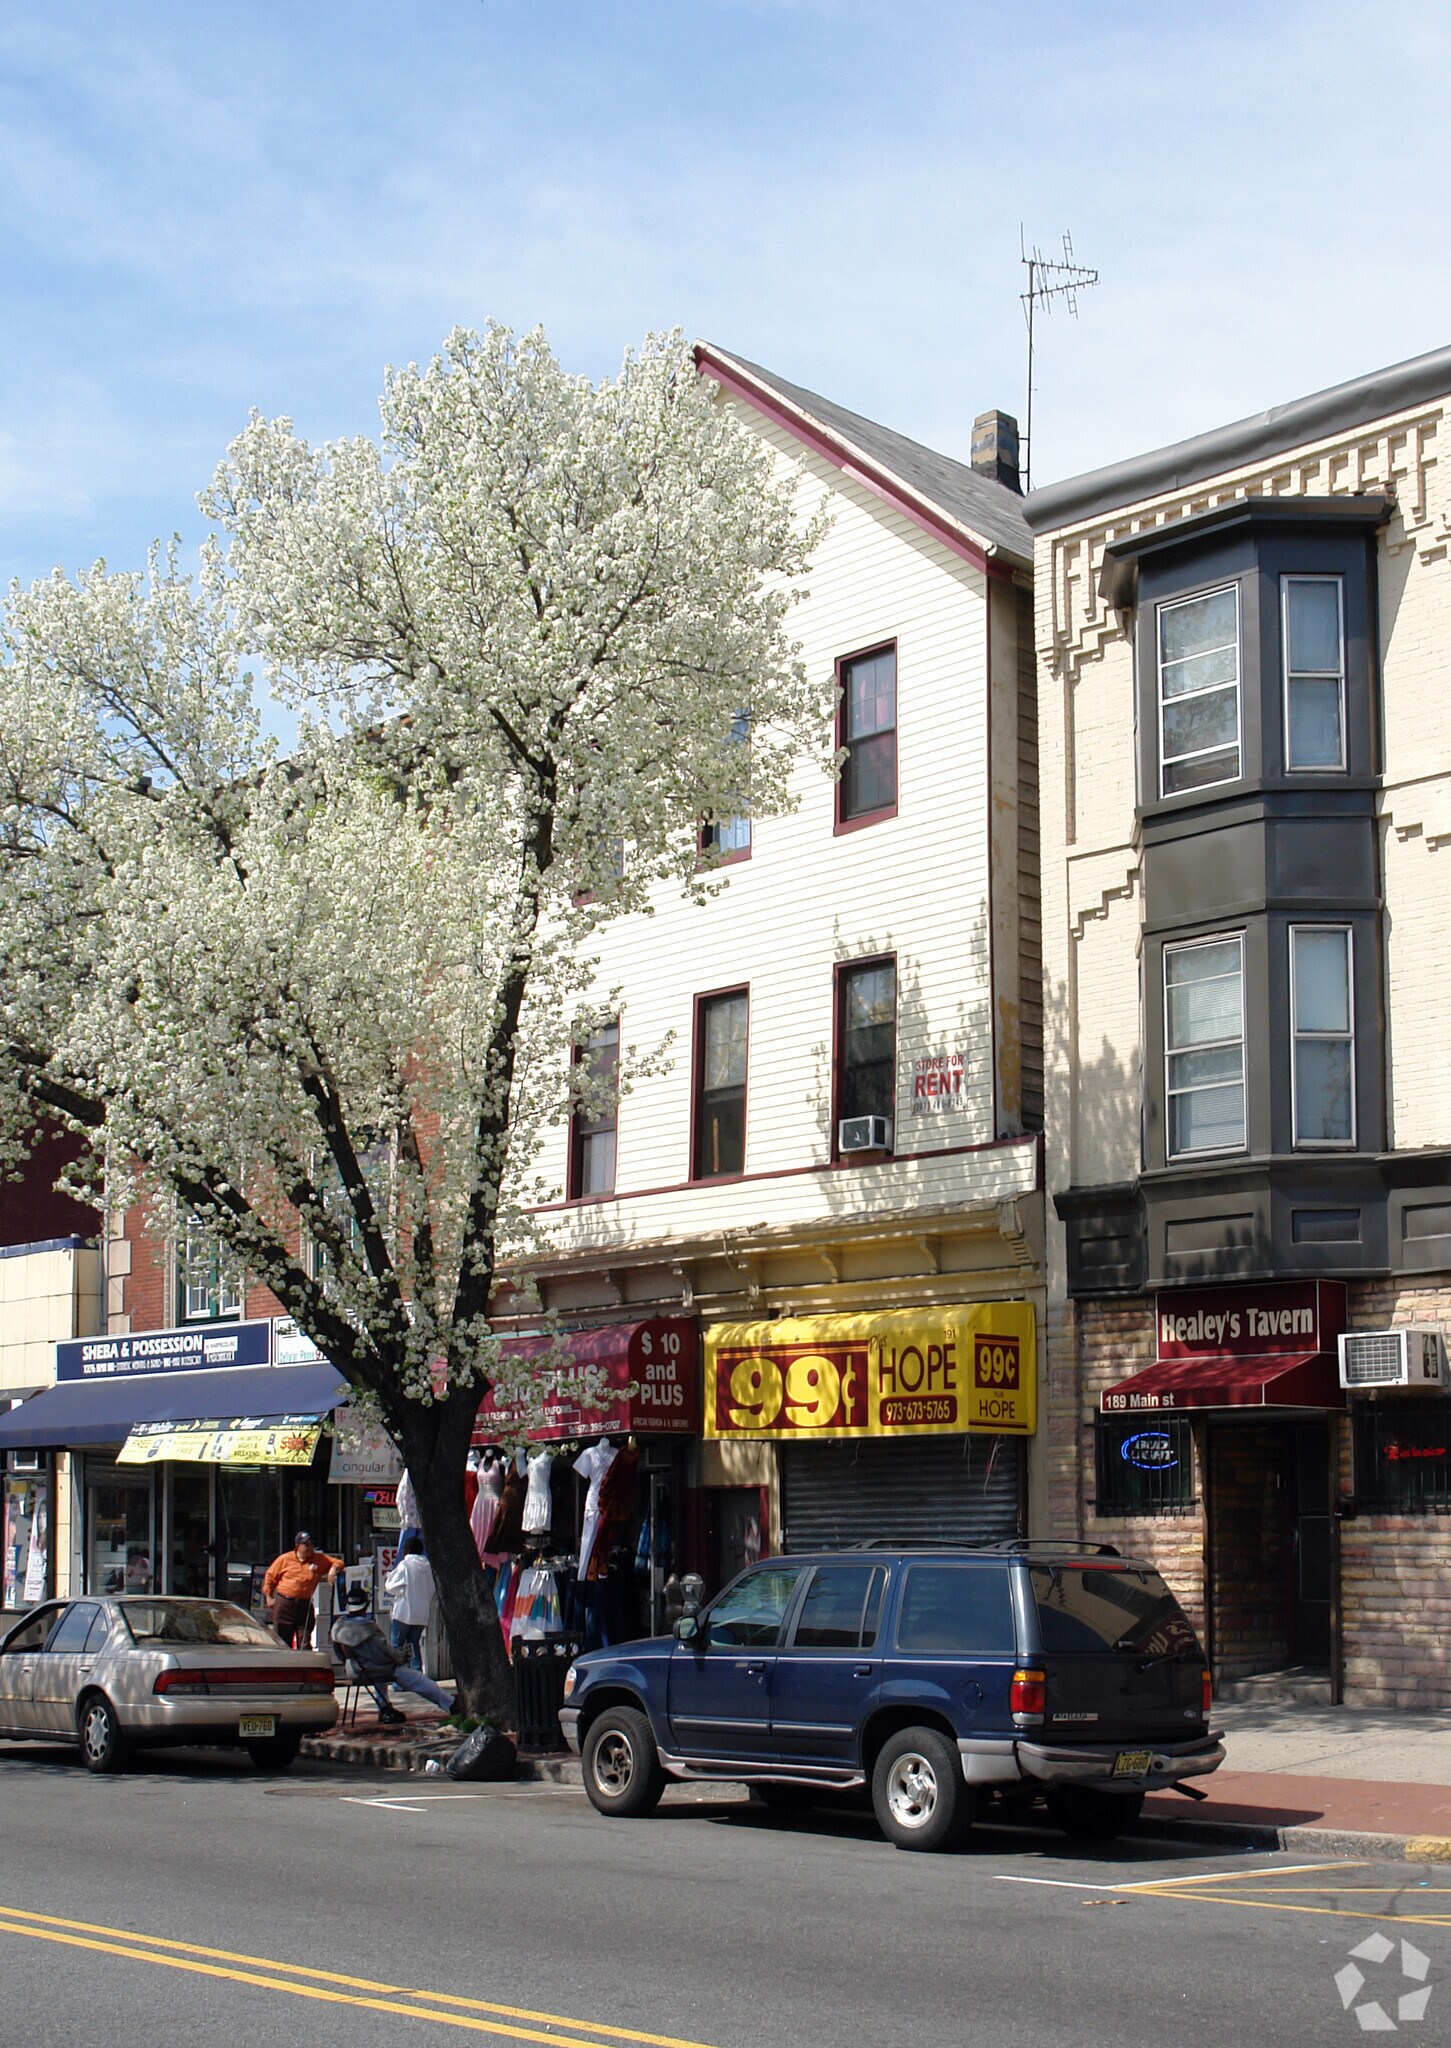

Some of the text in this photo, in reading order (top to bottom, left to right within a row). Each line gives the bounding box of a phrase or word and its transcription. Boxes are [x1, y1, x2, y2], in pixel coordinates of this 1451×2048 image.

[916, 1053, 964, 1071] STORE FOR
[915, 1069, 964, 1098] RENT
[944, 1329, 956, 1339] 191
[1161, 1308, 1313, 1345] Healey's Tavern
[82, 1343, 119, 1361] SHEBA
[120, 1343, 130, 1357] &
[132, 1335, 203, 1356] POSSESSION
[660, 1333, 681, 1355] 10
[645, 1360, 676, 1381] and
[879, 1343, 956, 1393] HOPE
[980, 1345, 1016, 1383] 99¢
[640, 1384, 684, 1407] PLUS
[729, 1355, 856, 1429] 99¢
[1105, 1392, 1174, 1409] 189 Main st
[979, 1400, 1016, 1419] HOPE
[342, 1461, 385, 1474] cingular
